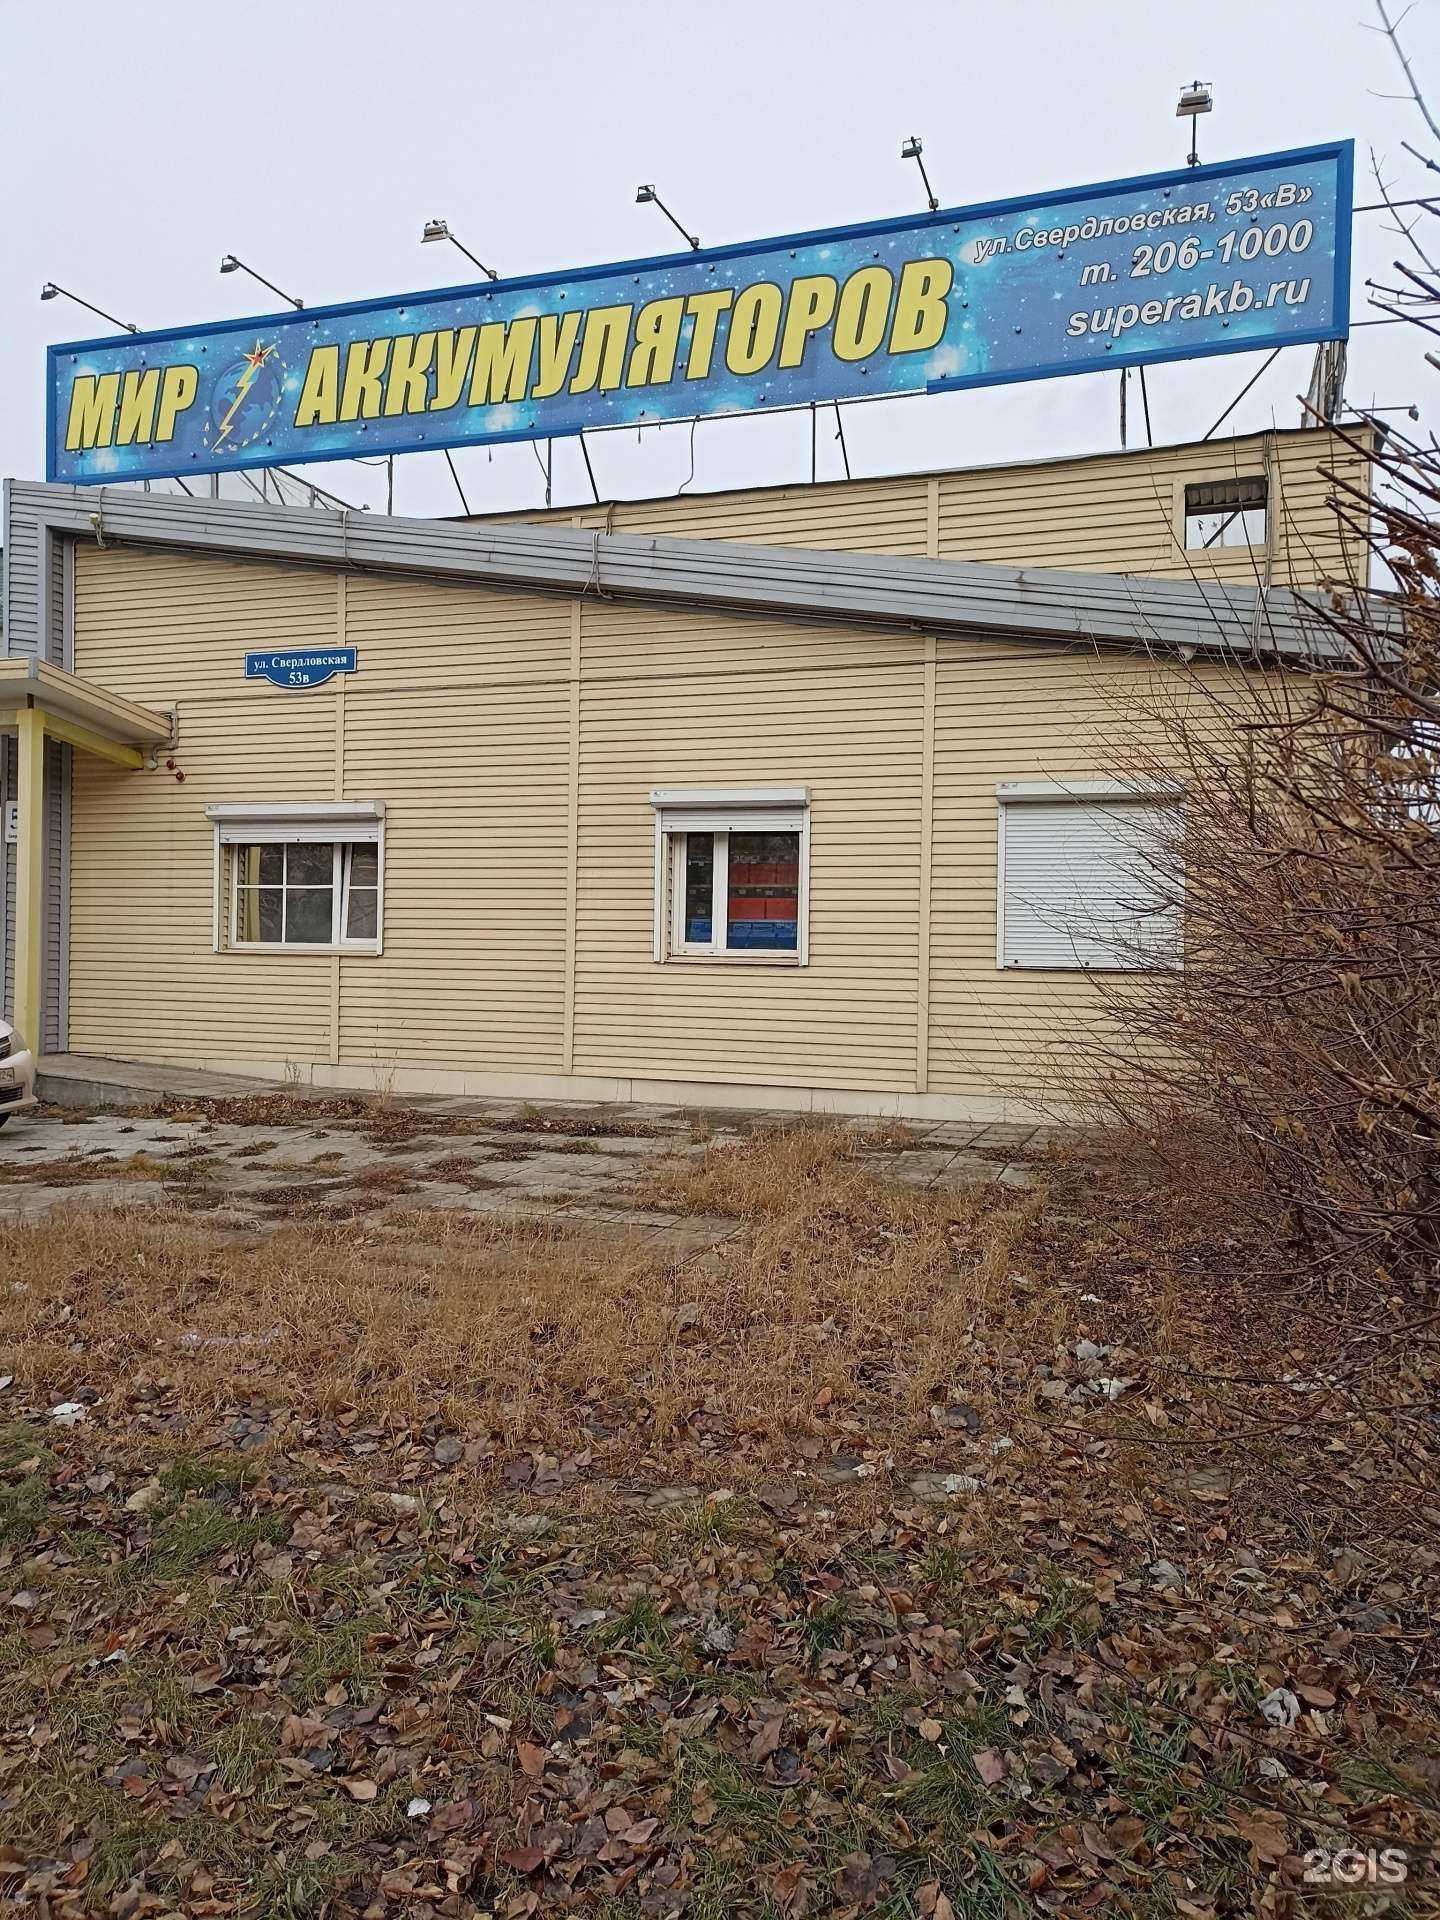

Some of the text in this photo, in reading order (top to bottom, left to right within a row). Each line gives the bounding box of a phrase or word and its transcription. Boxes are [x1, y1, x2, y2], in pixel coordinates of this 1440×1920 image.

[1226, 183, 1313, 216] 53«В»
[1130, 218, 1314, 279] 206-1000
[1065, 277, 1312, 338] superakb.ru
[64, 256, 955, 452] МИР АККУМУЛЯТОРОВ
[253, 656, 347, 672] ул. Свердловская
